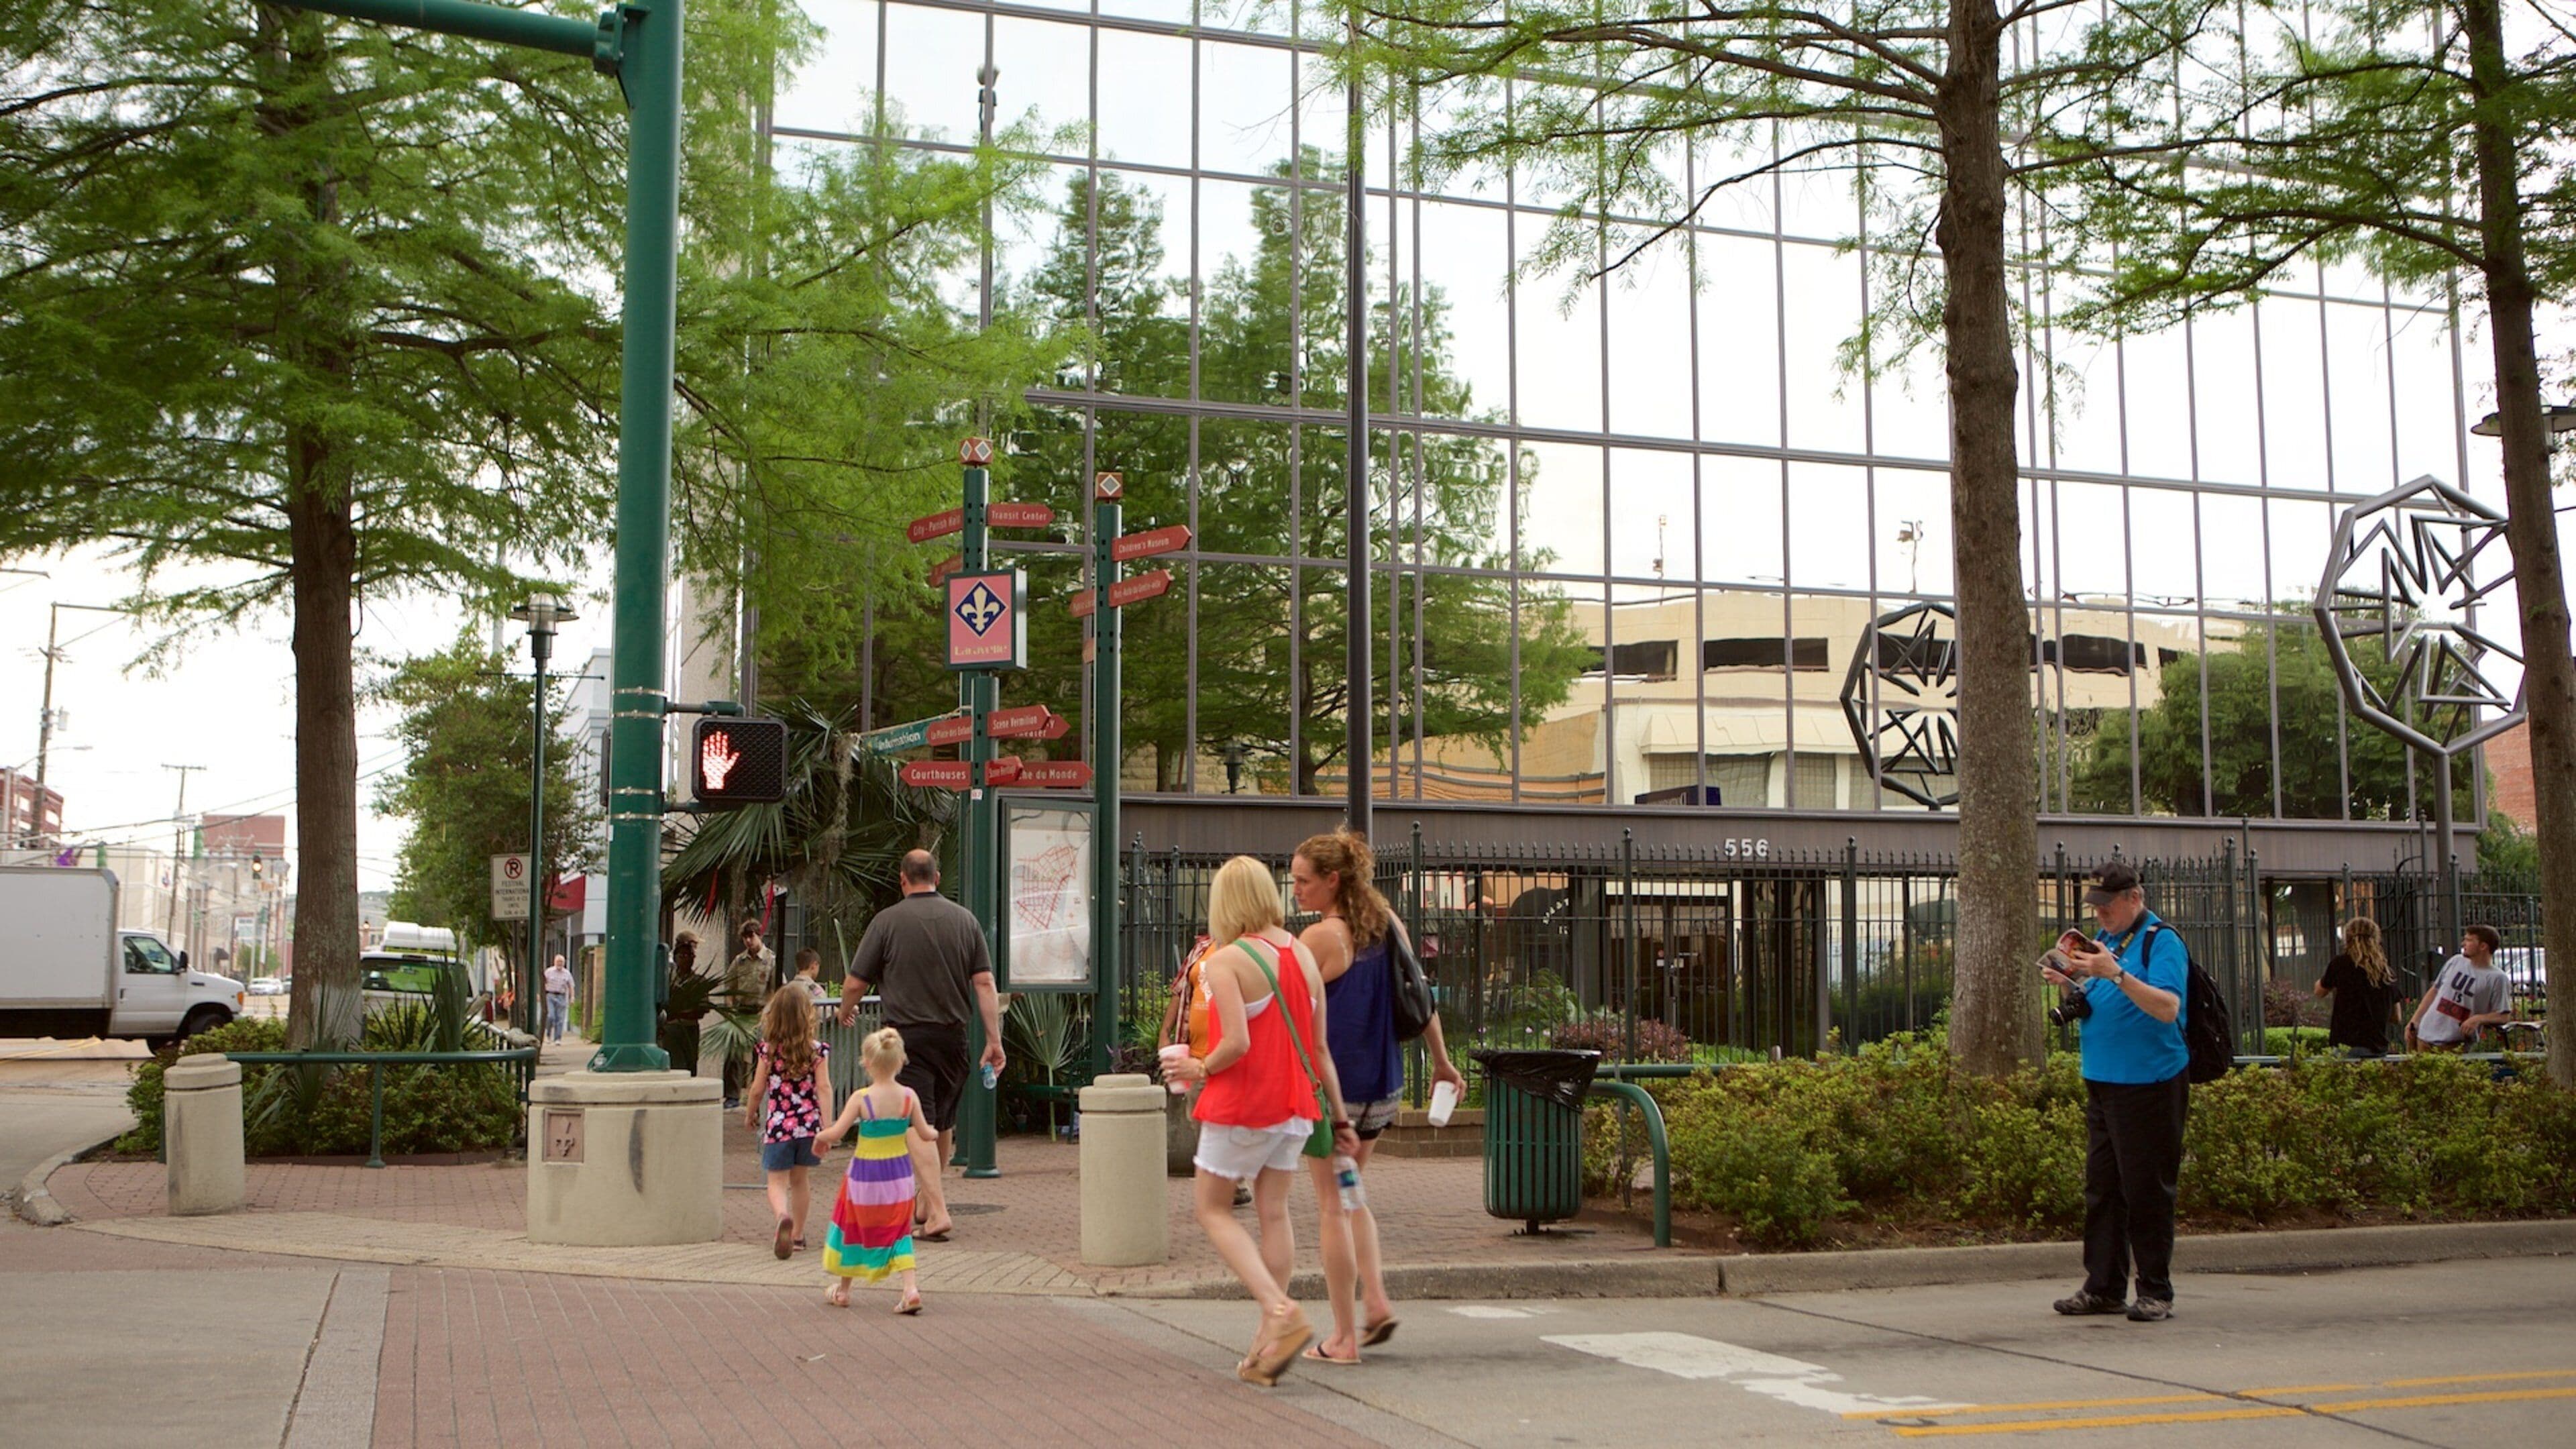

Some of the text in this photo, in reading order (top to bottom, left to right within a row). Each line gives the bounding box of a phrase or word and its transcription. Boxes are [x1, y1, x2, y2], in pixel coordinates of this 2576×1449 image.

[991, 510, 1047, 521] Transit Center
[1118, 537, 1170, 553] Children's Museum
[910, 769, 967, 780] Courthouses
[1035, 769, 1047, 780] du
[1049, 769, 1077, 780] Monde
[1724, 838, 1769, 857] 556
[495, 888, 529, 896] INTERNATIONA
[2451, 971, 2477, 998] UL
[2452, 991, 2463, 1004] IS
